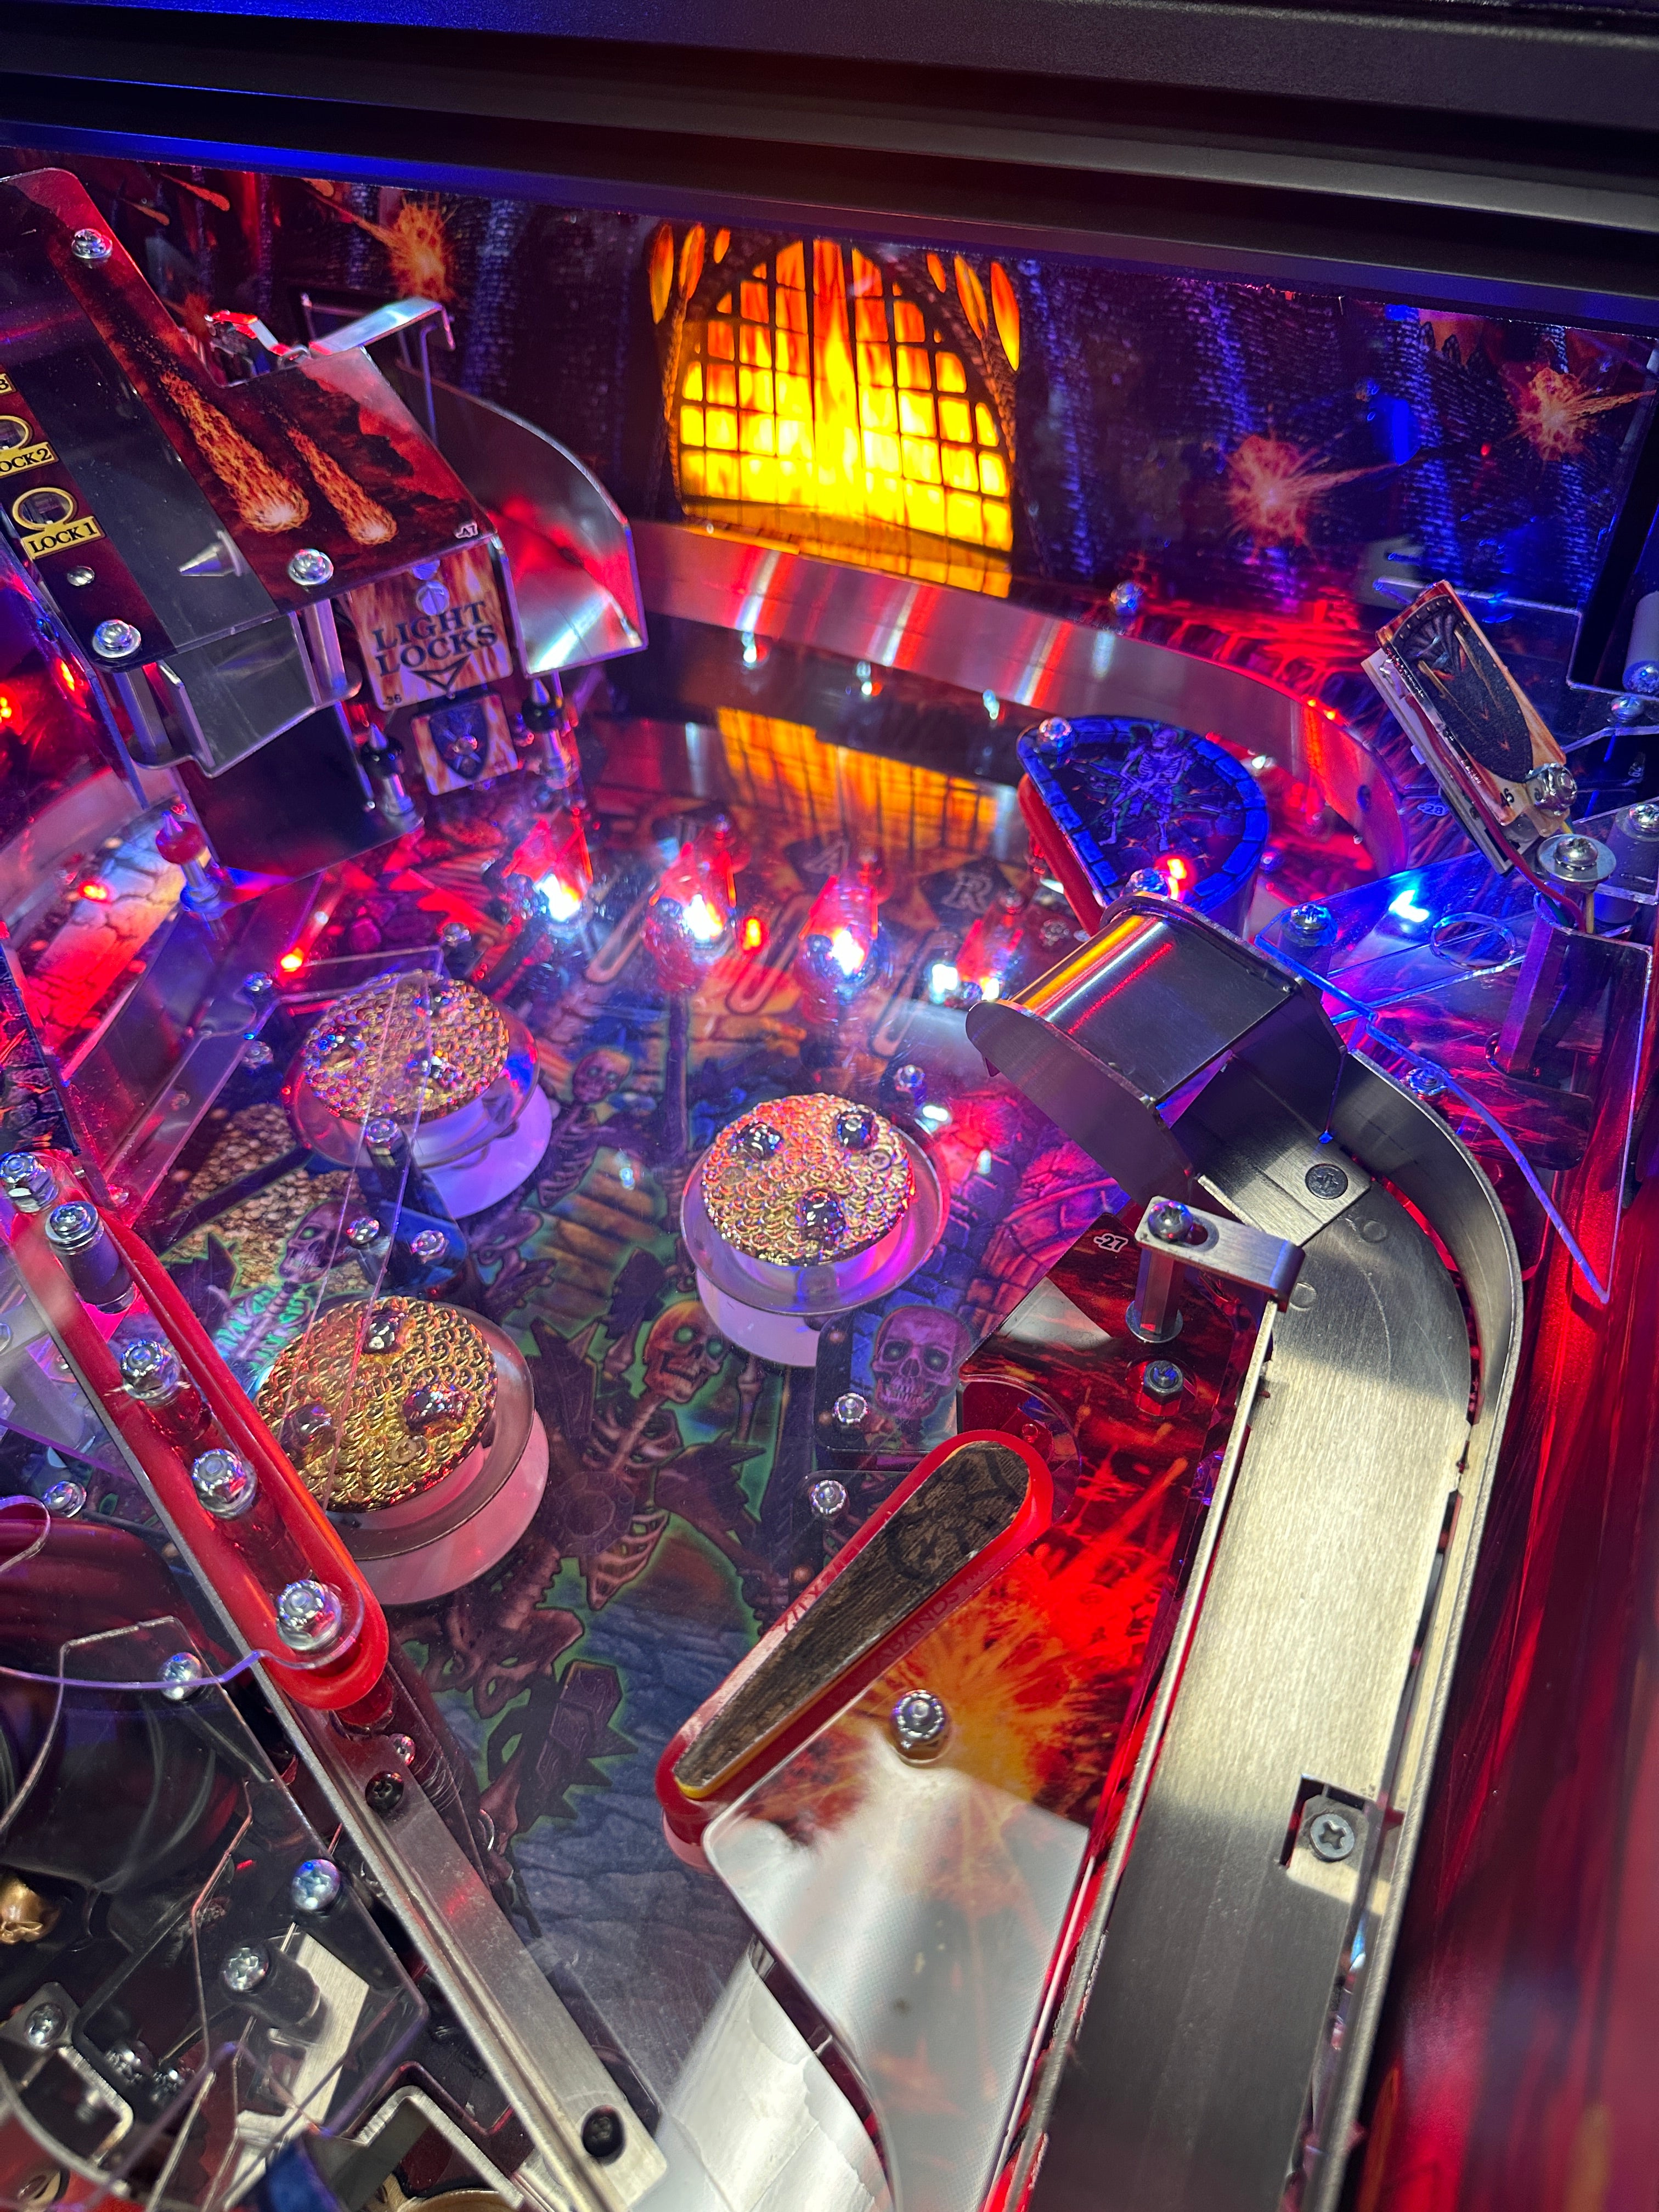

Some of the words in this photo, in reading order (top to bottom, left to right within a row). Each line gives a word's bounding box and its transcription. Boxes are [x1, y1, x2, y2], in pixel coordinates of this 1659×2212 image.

[0, 452, 40, 472] OCK
[37, 448, 52, 461] 2
[29, 526, 84, 554] LOCK
[83, 522, 98, 536] 1
[373, 601, 486, 652] LIGHT
[376, 624, 498, 676] LOCKS
[1096, 1235, 1126, 1251] -27
